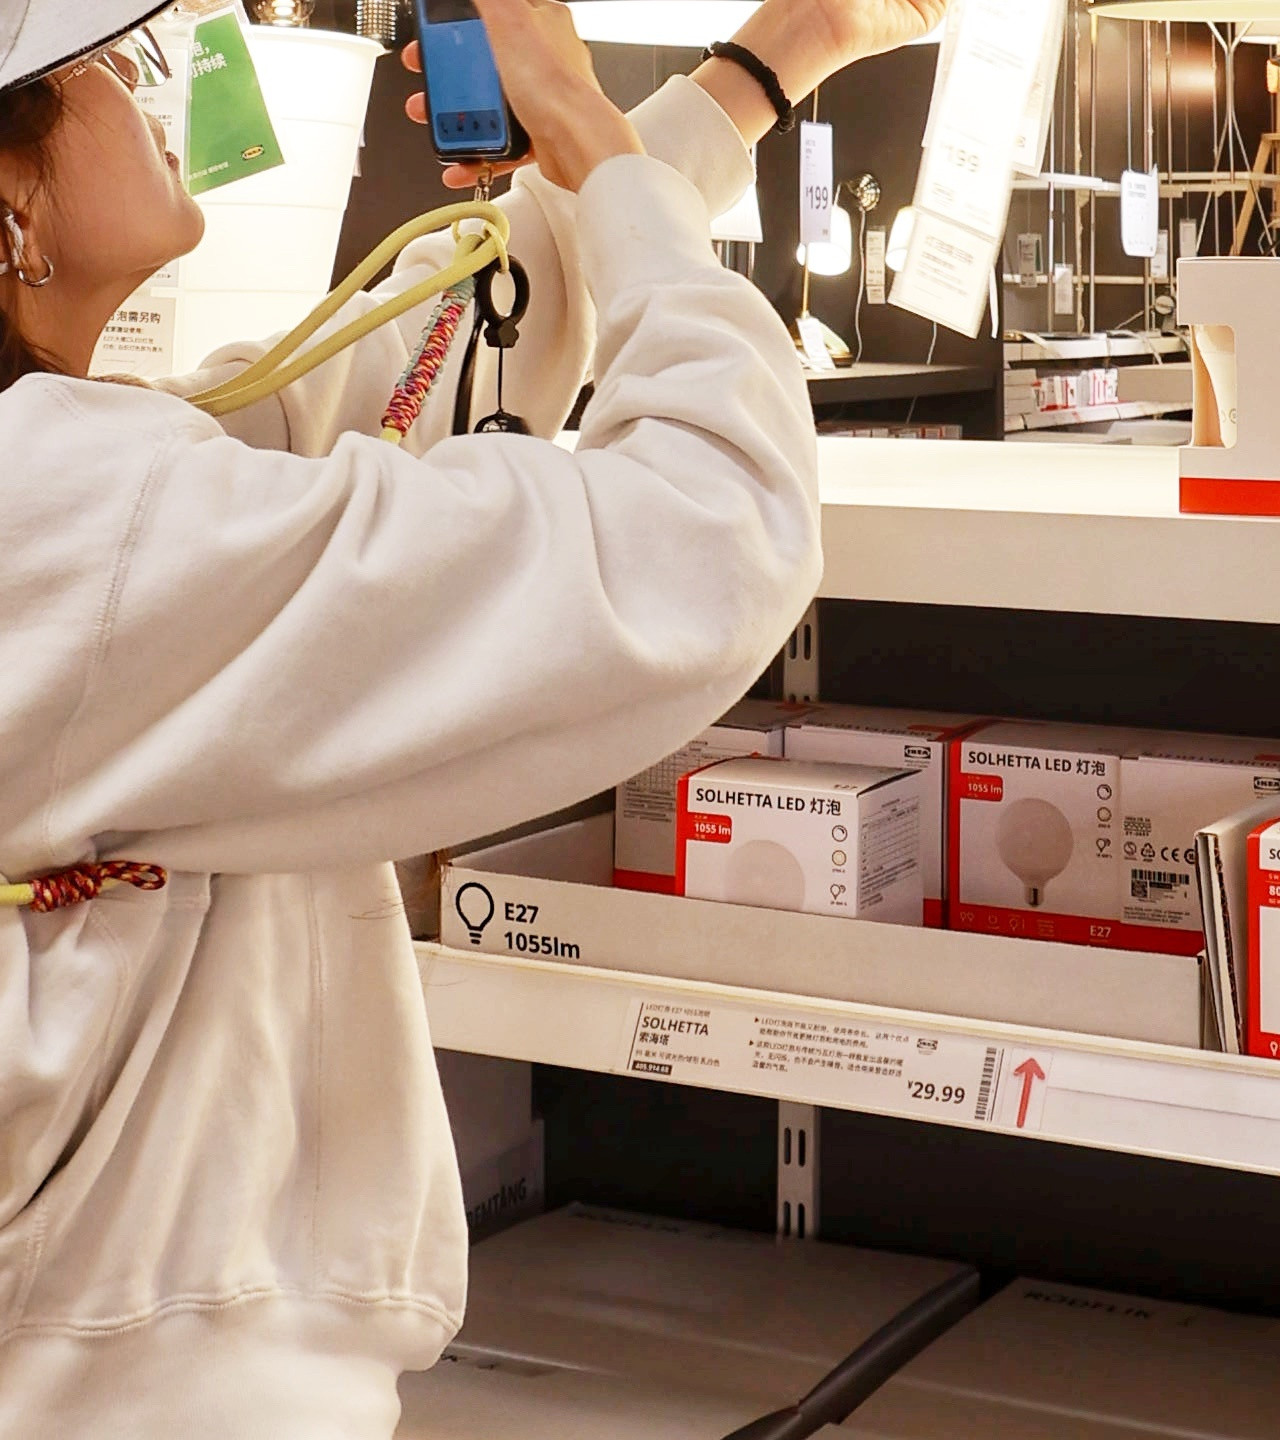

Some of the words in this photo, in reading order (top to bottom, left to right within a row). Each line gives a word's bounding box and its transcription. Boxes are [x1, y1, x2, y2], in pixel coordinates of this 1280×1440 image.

[968, 750, 1042, 771] SOLHETTA
[1045, 756, 1073, 773] LED
[1075, 758, 1106, 777] 灯泡
[967, 782, 989, 795] 1055
[695, 787, 773, 810] SOLHETTA
[776, 794, 806, 812] LED
[809, 797, 842, 817] 灯泡
[694, 822, 718, 835] 1055
[718, 823, 732, 837] lm
[504, 902, 539, 924] E27
[1089, 924, 1113, 939] E27
[504, 931, 581, 960] 1055lm
[641, 1016, 709, 1036] SOLHETTA
[638, 1032, 671, 1047] 索海塔
[906, 1078, 967, 1105] ¥29.99
